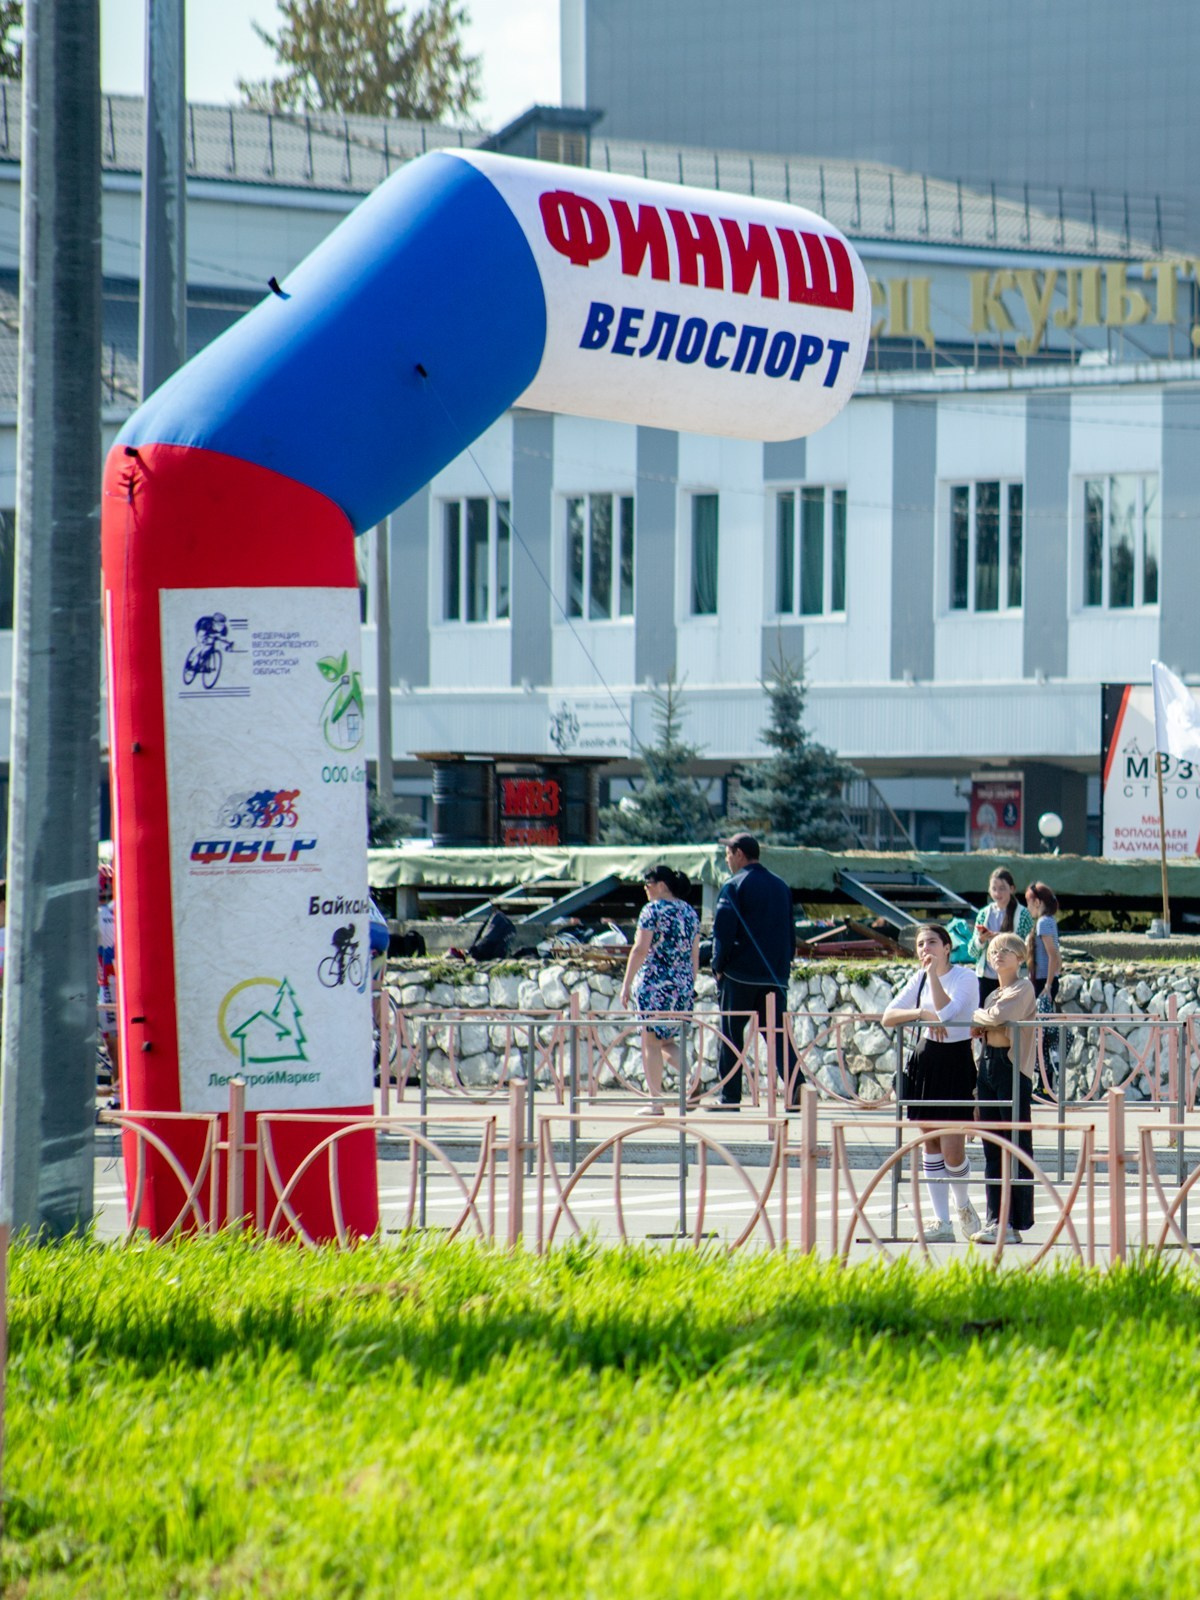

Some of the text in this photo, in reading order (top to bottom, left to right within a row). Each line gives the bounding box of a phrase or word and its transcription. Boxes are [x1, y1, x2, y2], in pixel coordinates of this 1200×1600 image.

[539, 189, 855, 312] ФИНИШ
[579, 301, 850, 388] ВЕЛОСПОРТ
[1112, 841, 1190, 852] ЗАДУМАНОЕ
